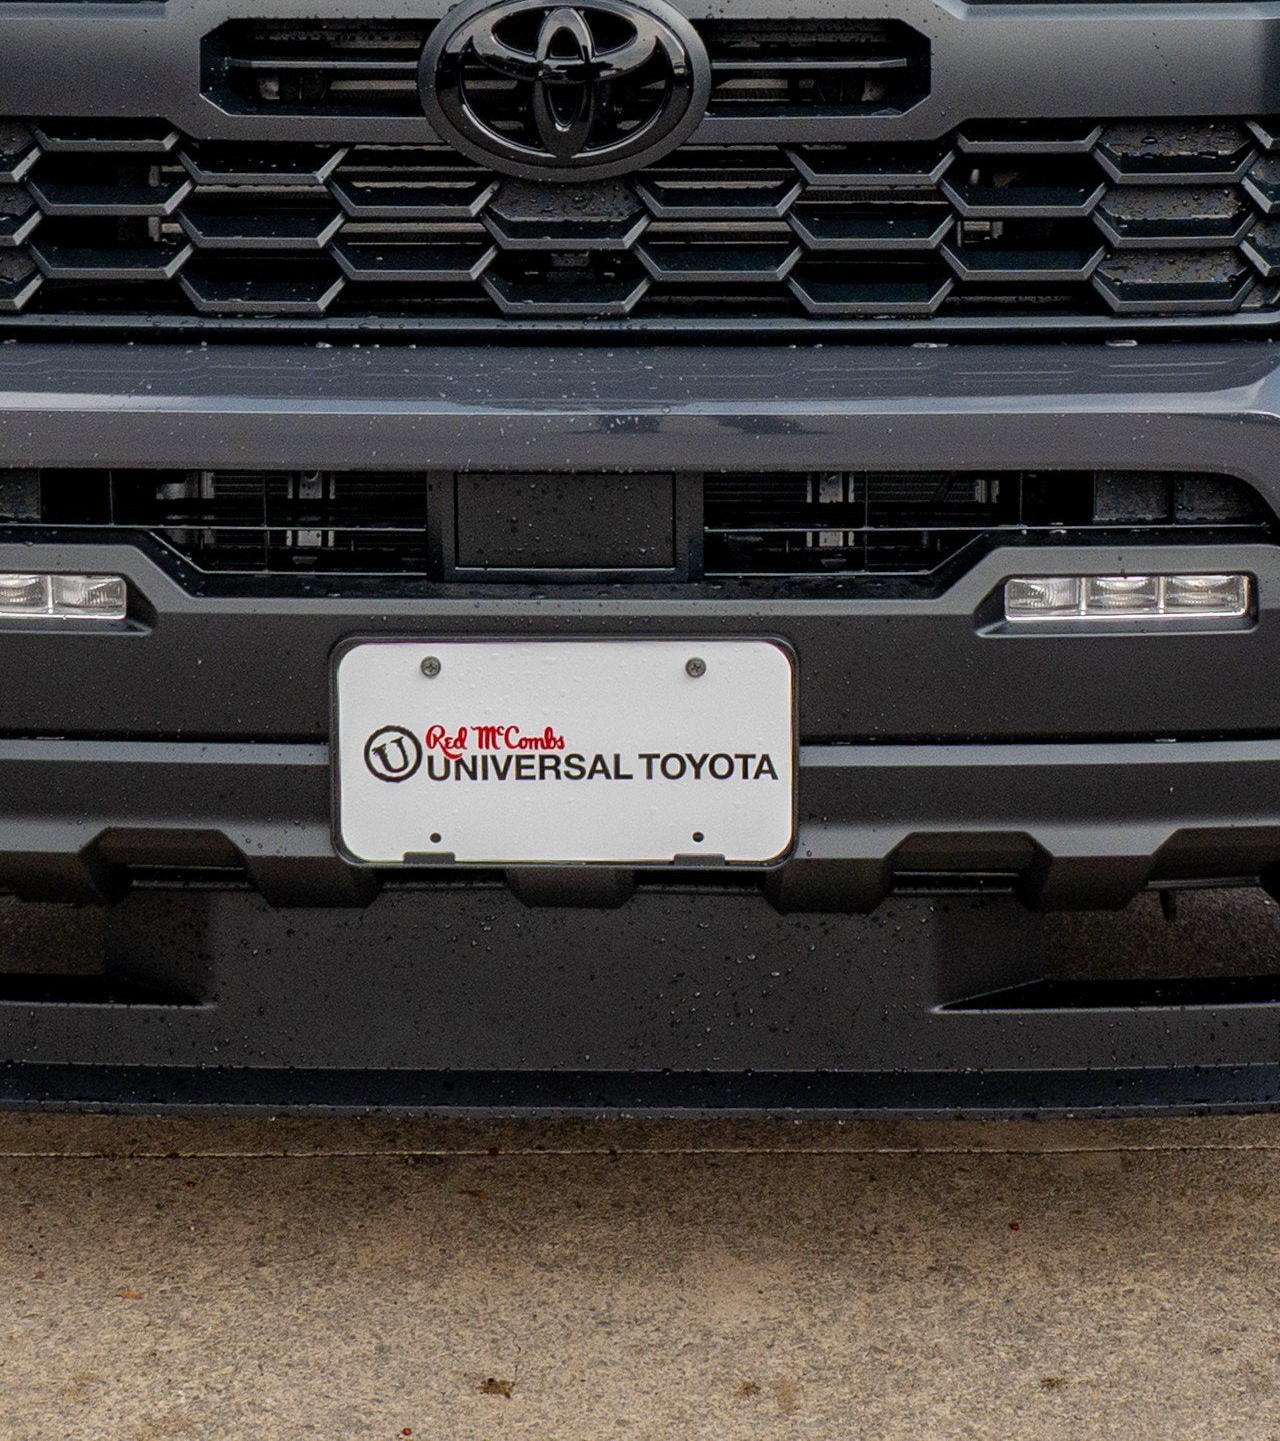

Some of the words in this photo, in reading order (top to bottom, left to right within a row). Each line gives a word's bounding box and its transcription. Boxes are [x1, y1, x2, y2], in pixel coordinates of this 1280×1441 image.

[425, 724, 469, 760] Red
[470, 725, 566, 750] McCombs
[427, 753, 634, 781] UNIVERSAL
[638, 753, 779, 780] TOYOTA
